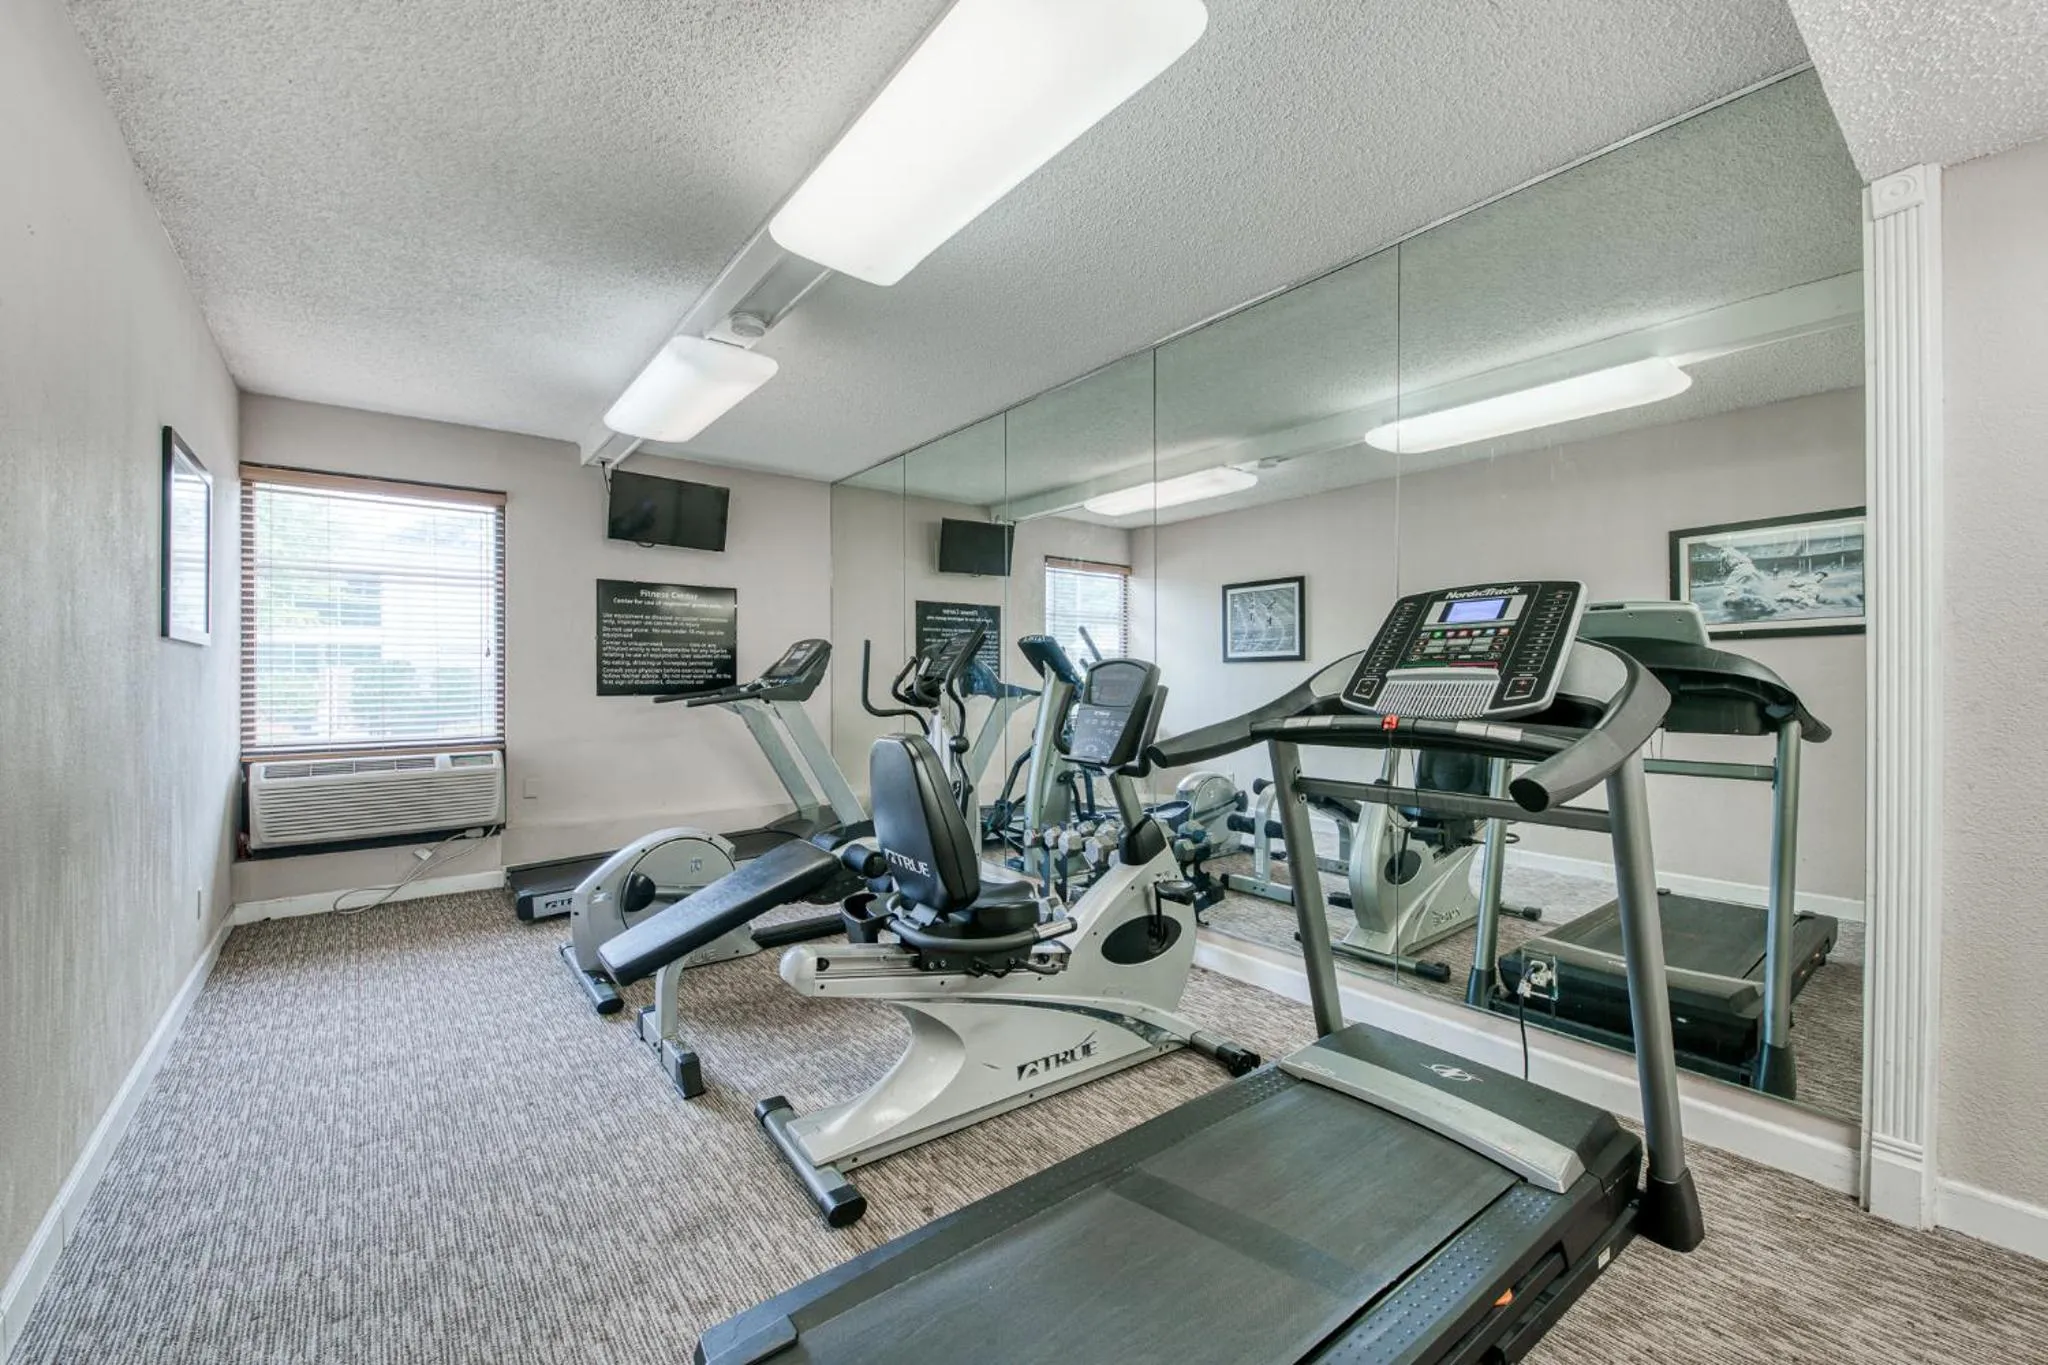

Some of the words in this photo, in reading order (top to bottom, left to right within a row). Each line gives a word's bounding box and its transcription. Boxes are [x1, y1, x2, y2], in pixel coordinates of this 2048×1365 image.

[640, 589, 669, 599] Fitness
[1445, 586, 1520, 599] NordicTrack
[895, 852, 931, 878] TRUE
[1038, 1039, 1099, 1073] TRUE
